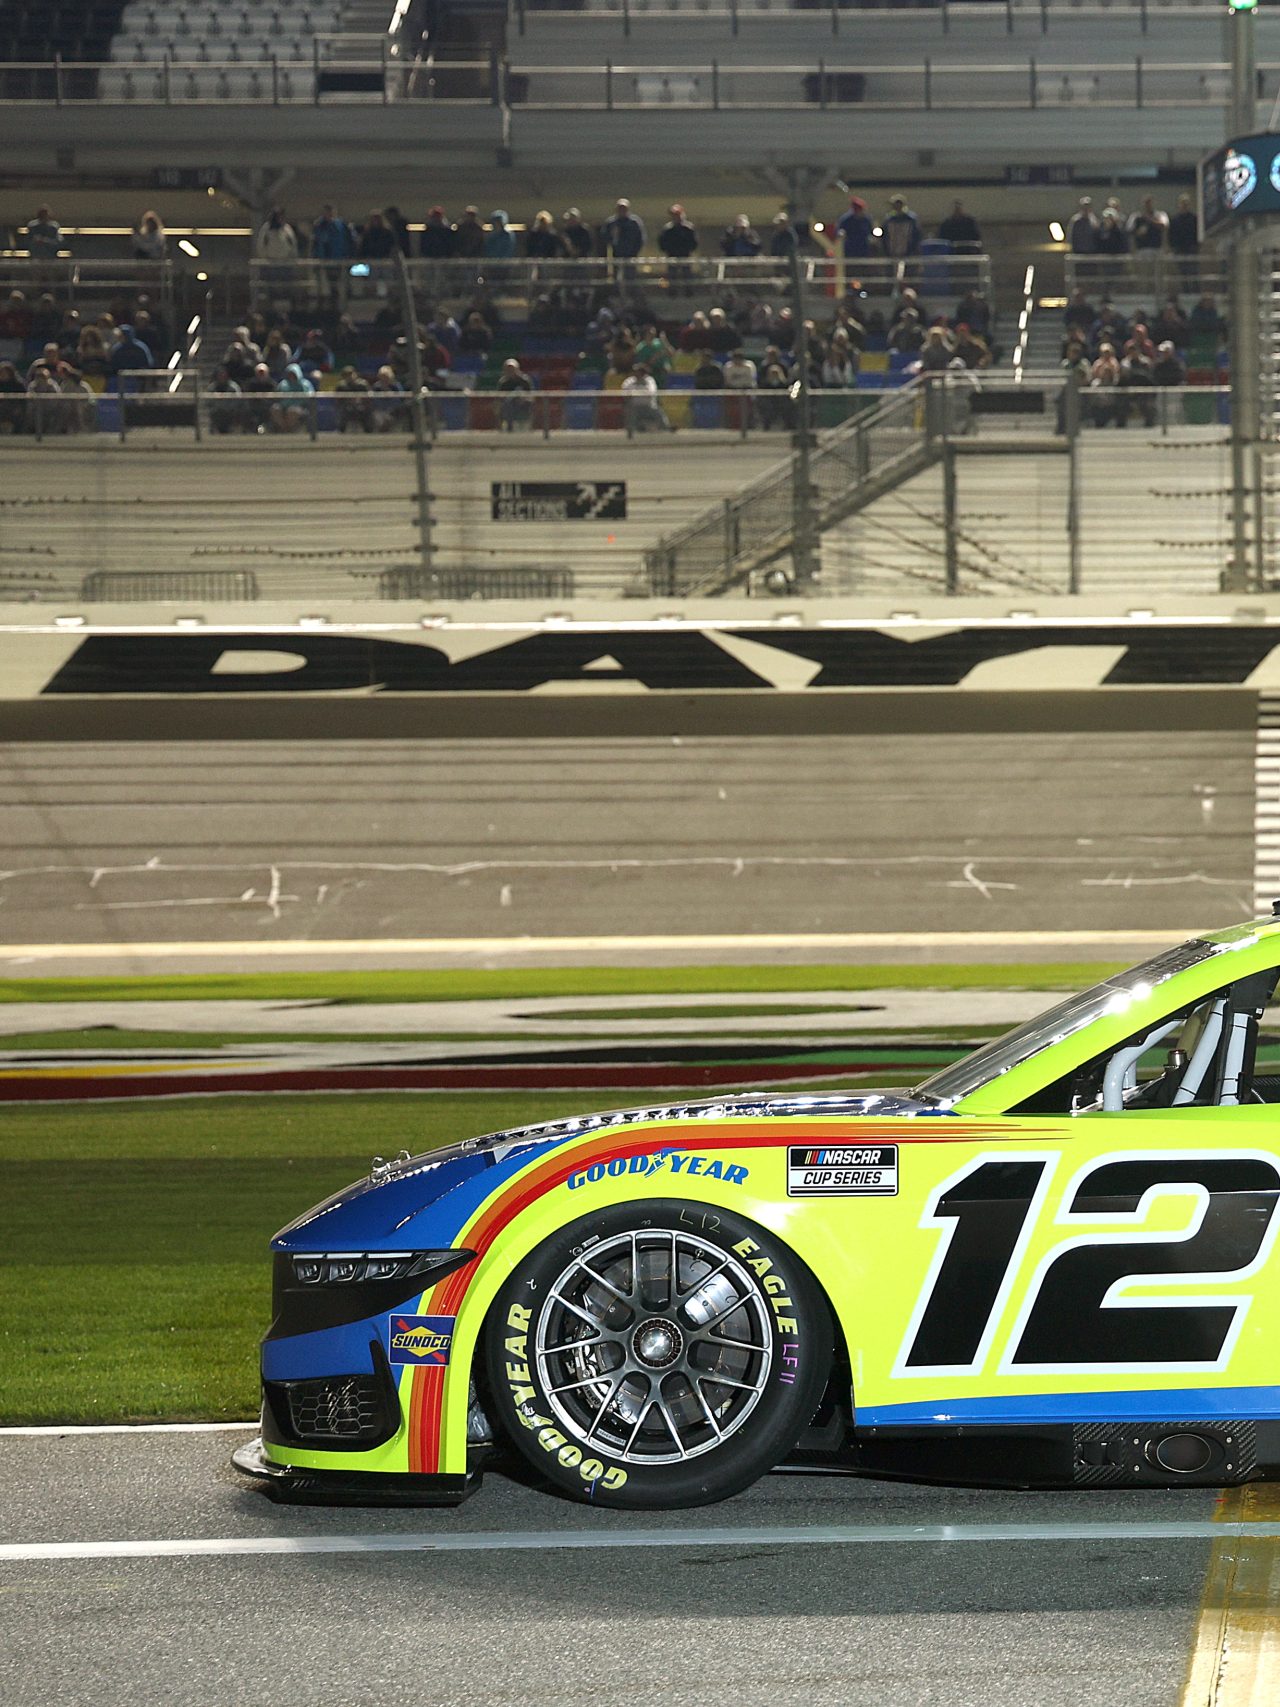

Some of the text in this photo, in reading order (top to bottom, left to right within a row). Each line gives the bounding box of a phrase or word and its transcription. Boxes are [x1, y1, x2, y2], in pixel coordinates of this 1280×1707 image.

[566, 1147, 749, 1190] GOODYEAR
[823, 1150, 881, 1164] NASCAR
[803, 1171, 882, 1184] CUP SERIES
[732, 1237, 799, 1335] EAGLE
[392, 1333, 451, 1349] SUNOCO
[505, 1303, 628, 1490] GOODYEAR
